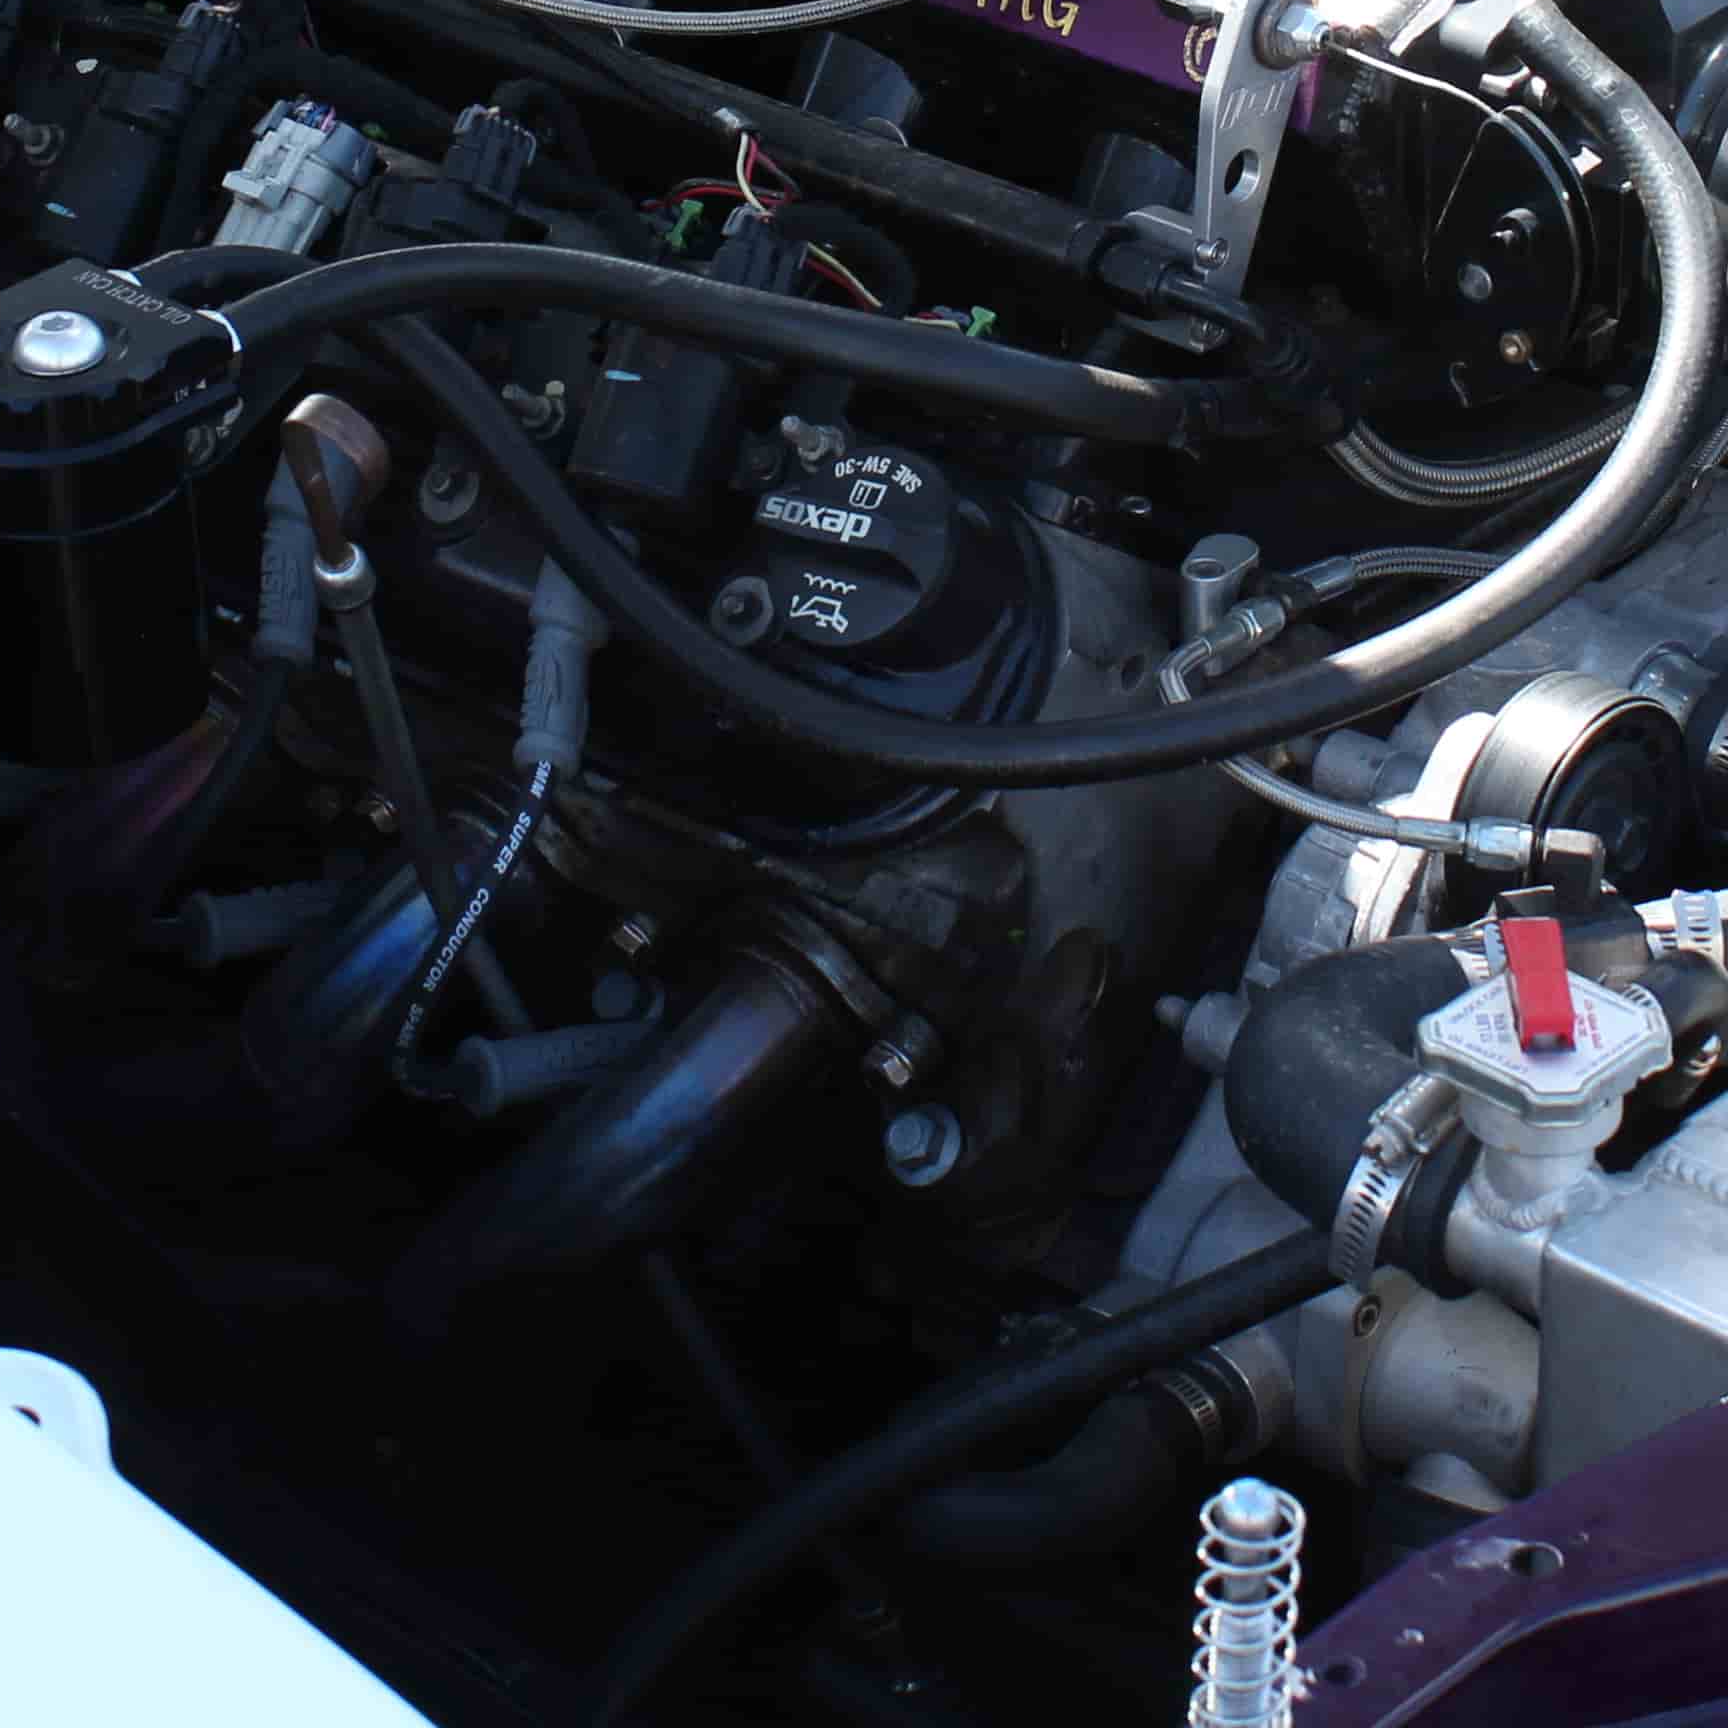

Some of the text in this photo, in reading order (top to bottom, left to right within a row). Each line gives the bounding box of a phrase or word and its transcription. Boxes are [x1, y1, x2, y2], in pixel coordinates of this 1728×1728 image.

[834, 455, 922, 494] SAE 5W-30
[759, 496, 872, 543] dexos
[493, 810, 532, 875] SUPER
[423, 886, 490, 993] CONDUCTOR
